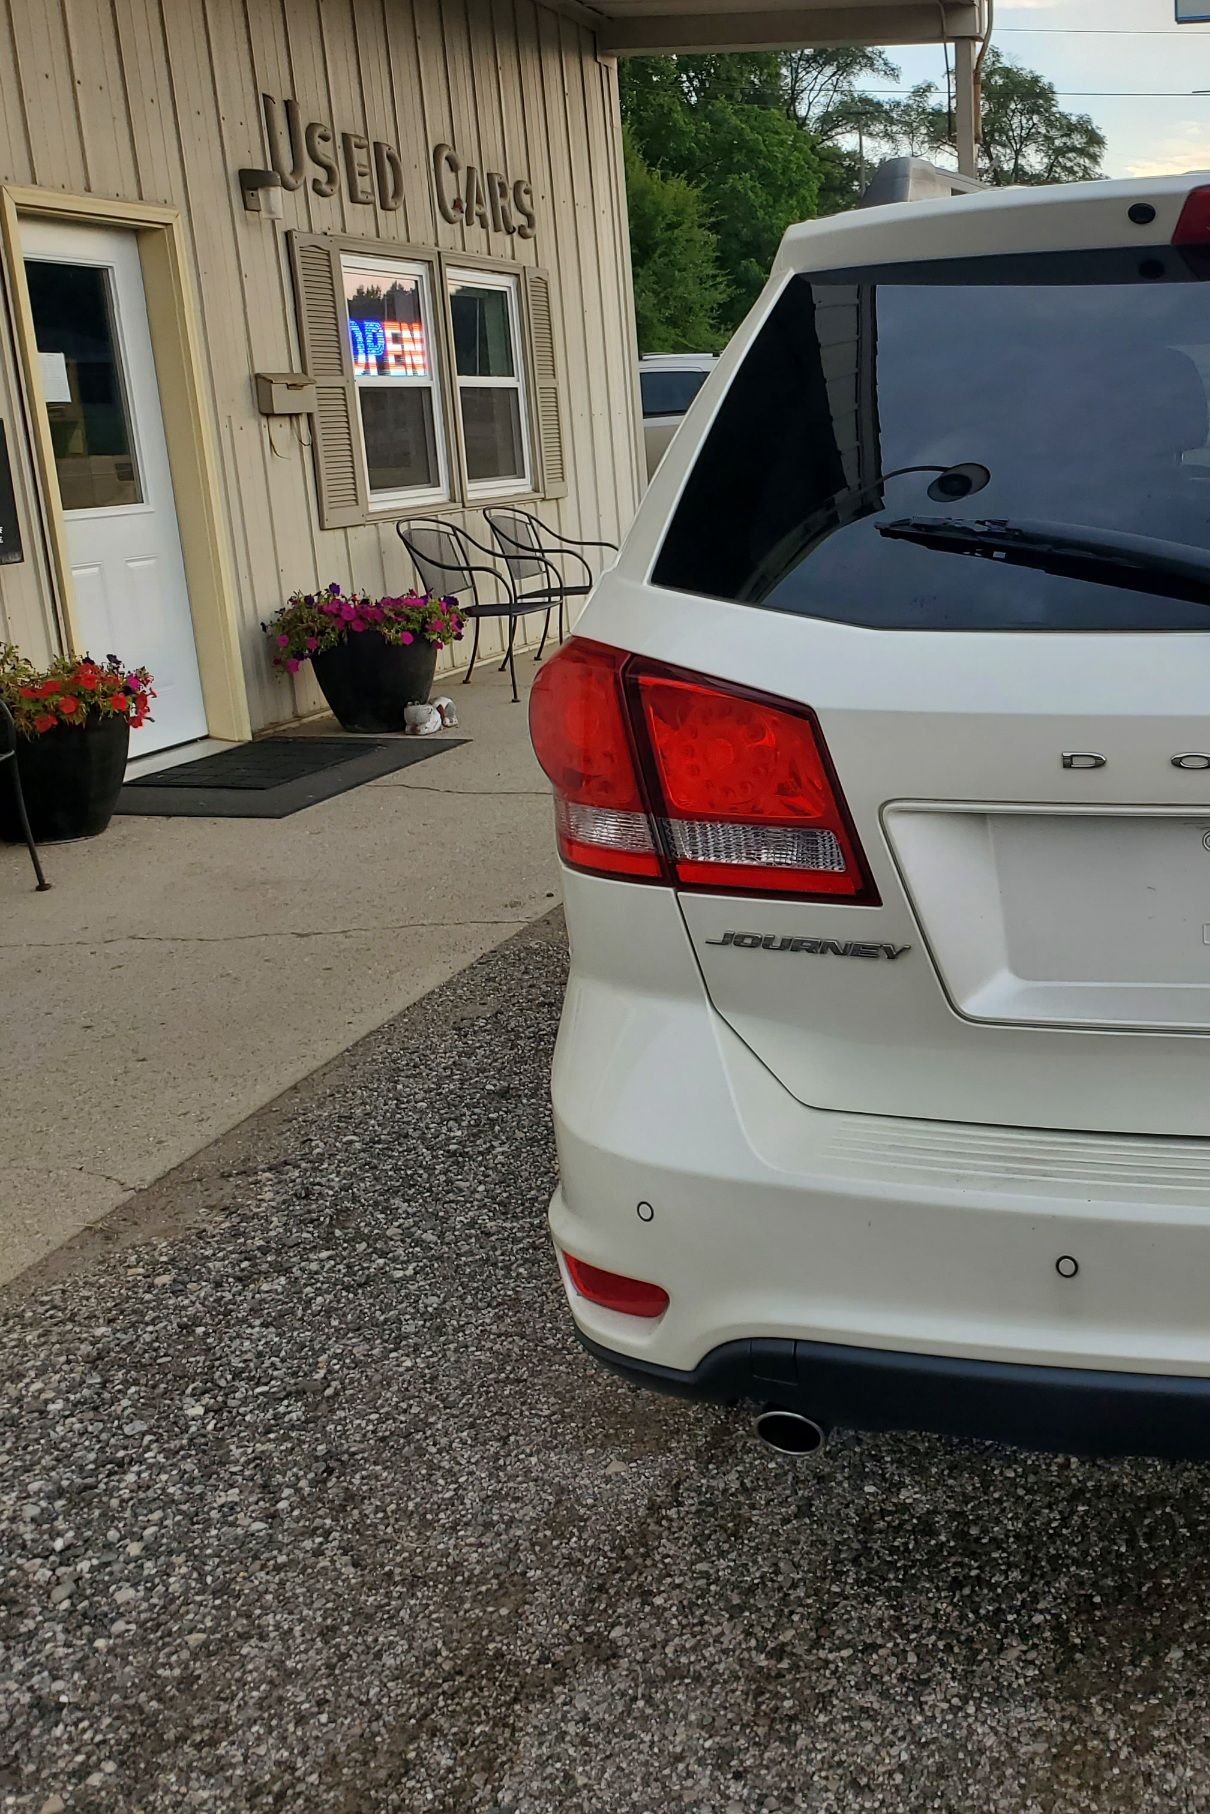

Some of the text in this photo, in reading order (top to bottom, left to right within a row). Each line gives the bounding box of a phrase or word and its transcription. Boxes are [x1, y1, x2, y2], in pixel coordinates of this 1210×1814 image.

[262, 93, 536, 239] USED CARS
[350, 319, 426, 376] OPEN
[704, 928, 912, 960] JOURNEY
